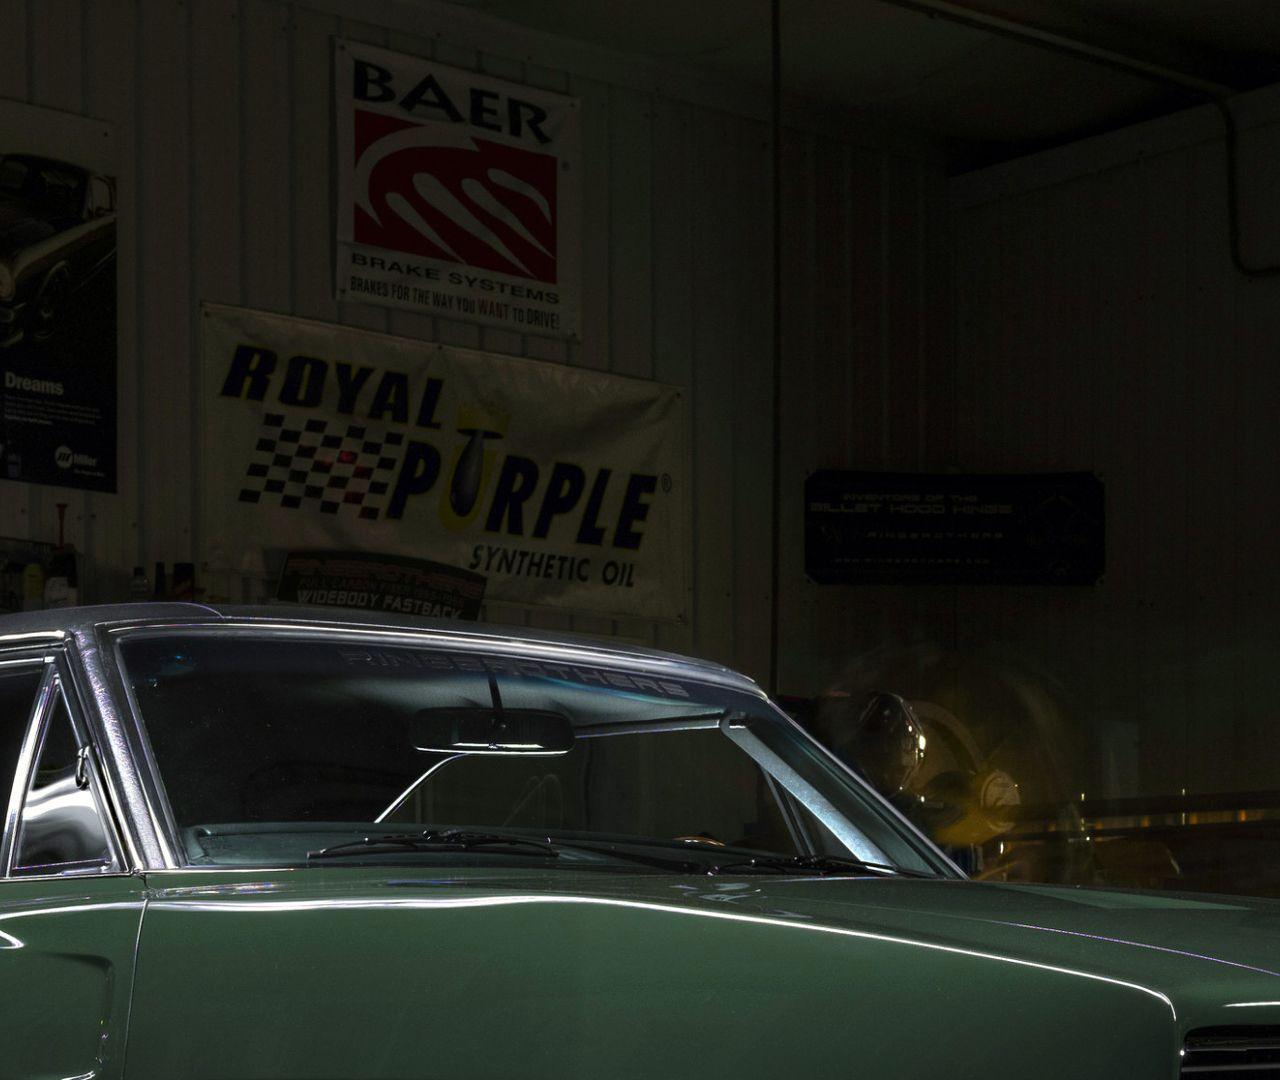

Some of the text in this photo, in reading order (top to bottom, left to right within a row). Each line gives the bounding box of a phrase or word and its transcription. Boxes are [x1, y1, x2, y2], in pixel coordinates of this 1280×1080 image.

[354, 60, 551, 143] BAER
[350, 276, 388, 298] BRAKES
[391, 283, 410, 301] FOR
[412, 287, 430, 305] THE
[432, 292, 457, 310] WAY
[457, 296, 476, 314] YOU
[478, 299, 509, 320] WANT
[527, 308, 560, 330] DRIVE!
[352, 252, 560, 304] BRAKE SYSTEMS
[4, 370, 64, 396] Dreams
[221, 345, 444, 429] ROYAL
[469, 545, 635, 588] SYNTHETIC OIL
[297, 589, 381, 608] WIDEBODY
[383, 594, 463, 619] FASTBACK
